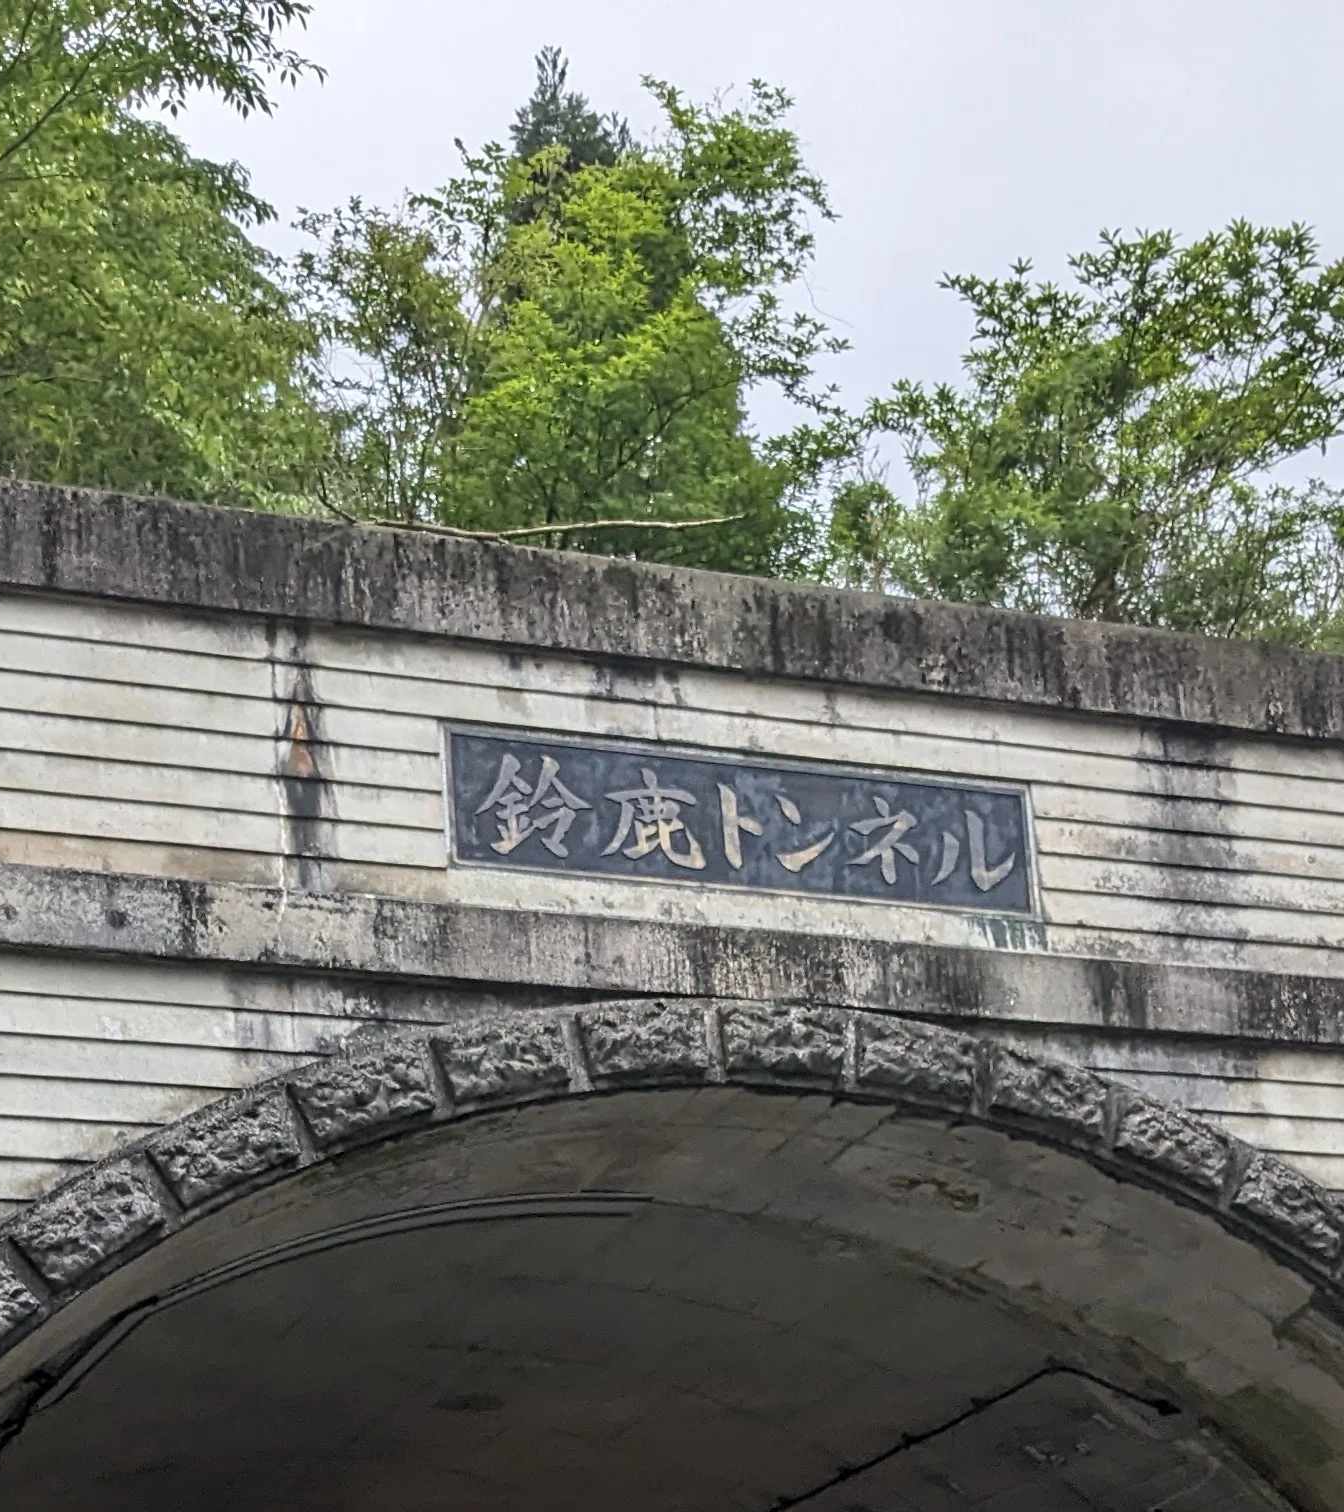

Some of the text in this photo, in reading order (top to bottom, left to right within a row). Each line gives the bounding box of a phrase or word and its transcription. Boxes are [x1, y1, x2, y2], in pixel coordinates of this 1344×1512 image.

[475, 753, 1016, 892] 鈴鹿トンネル
